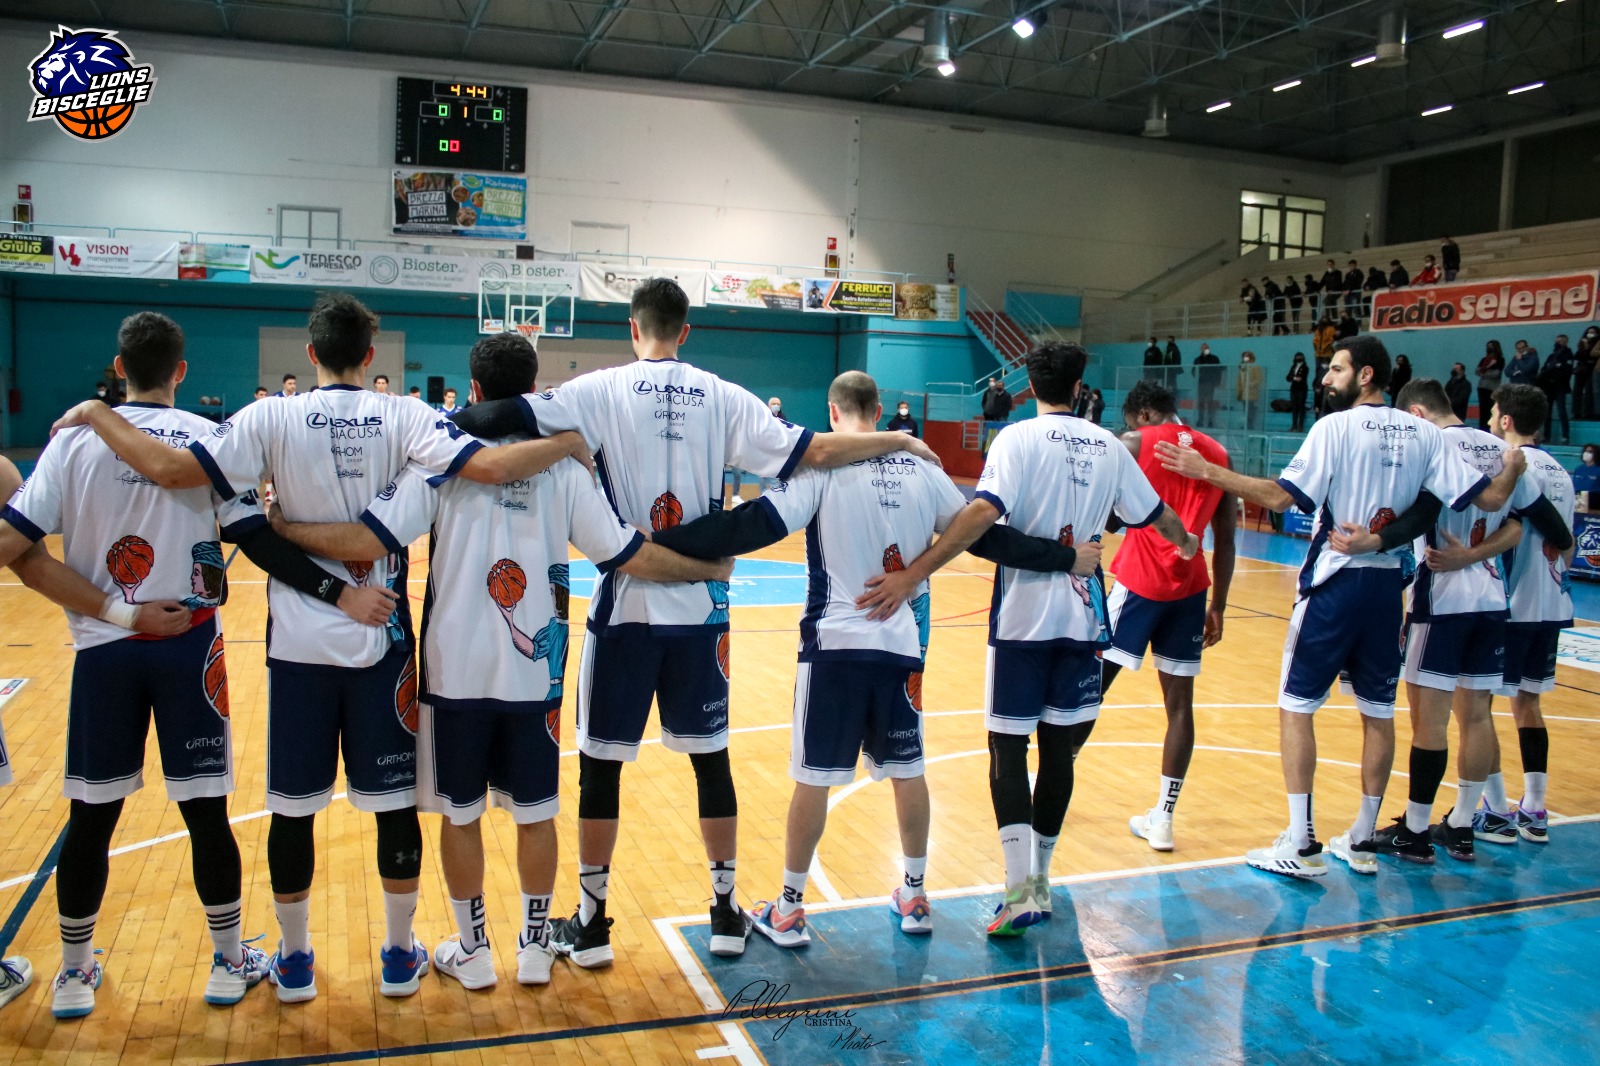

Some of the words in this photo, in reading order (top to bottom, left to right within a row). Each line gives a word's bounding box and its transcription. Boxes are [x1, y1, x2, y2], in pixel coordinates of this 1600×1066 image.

[439, 105, 448, 116] 0
[493, 109, 502, 121] 0
[86, 244, 129, 255] VISION
[302, 253, 362, 268] TEDESCO
[402, 257, 458, 273] Bioster
[511, 263, 565, 278] Boster
[842, 282, 892, 294] FERRUCCI
[1376, 291, 1455, 327] radio
[1458, 284, 1590, 322] selene
[654, 383, 705, 398] LEXUS
[329, 416, 383, 428] LEXUS
[1378, 424, 1417, 432] LEXUS
[138, 428, 190, 440] XUS
[1063, 433, 1107, 448] LEXUS
[377, 750, 416, 766] ORTHOM
